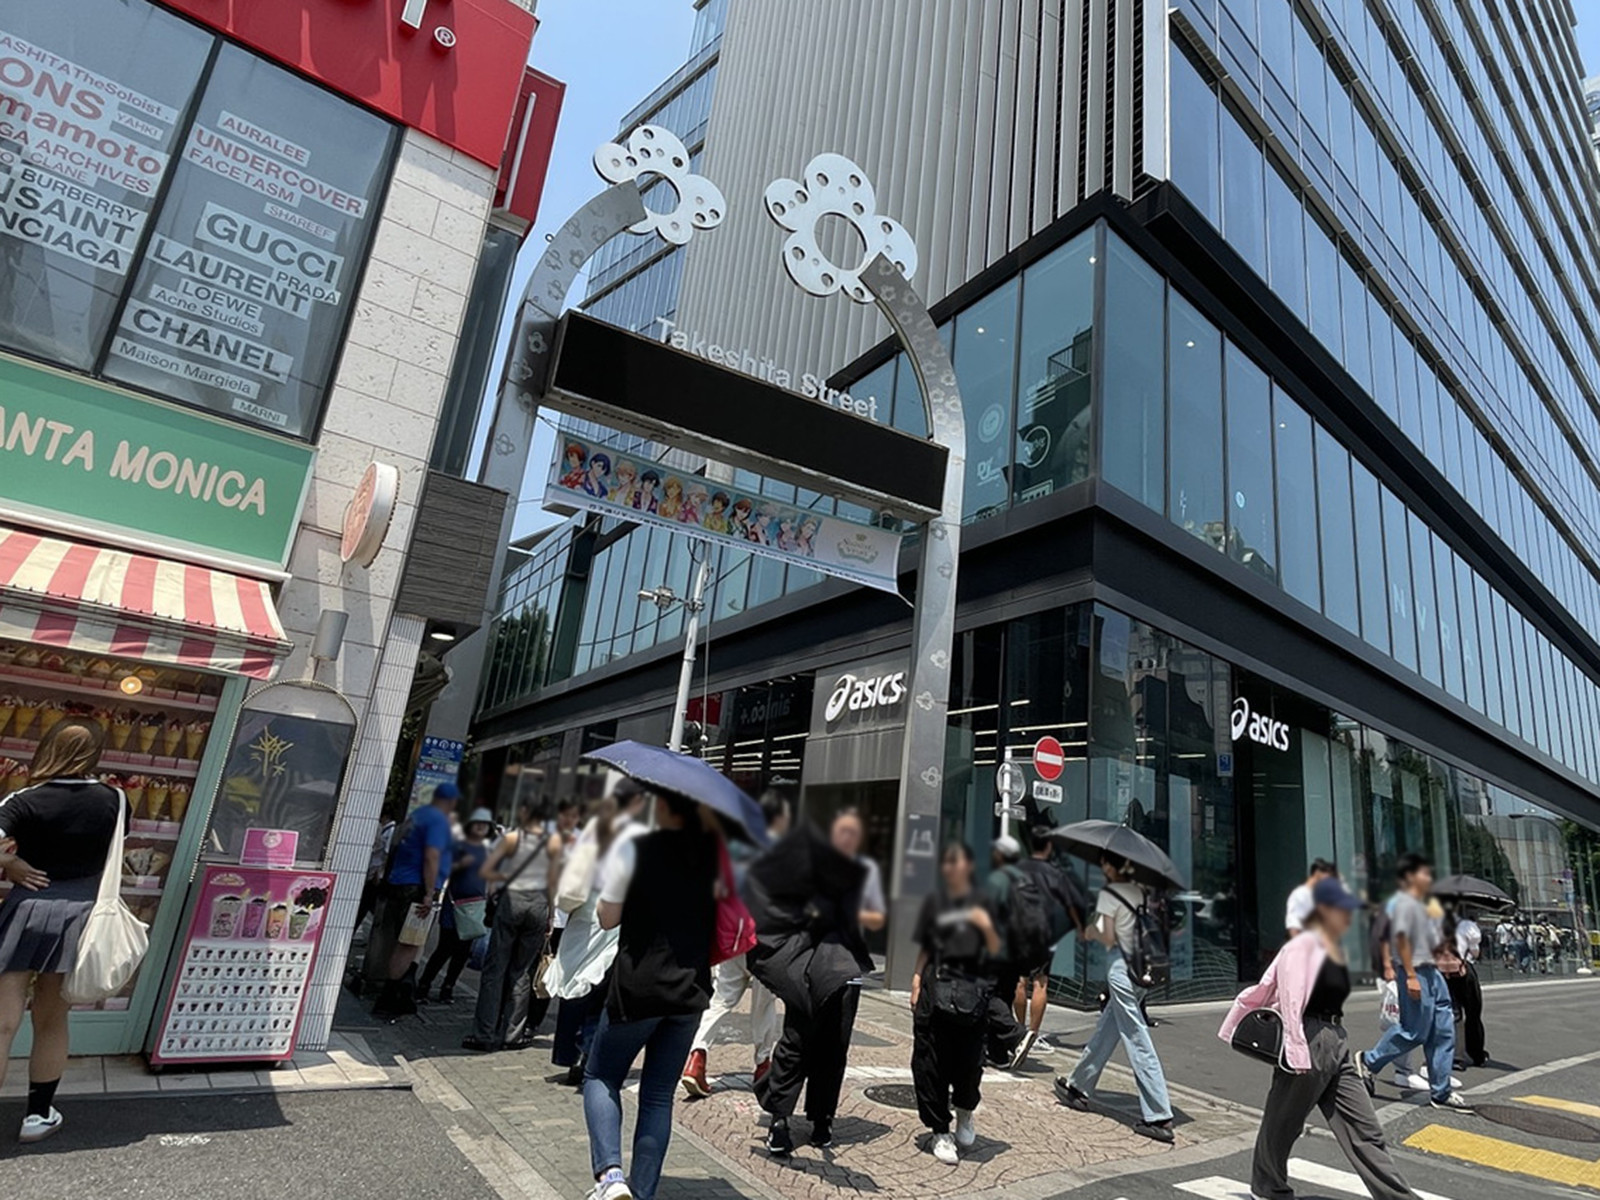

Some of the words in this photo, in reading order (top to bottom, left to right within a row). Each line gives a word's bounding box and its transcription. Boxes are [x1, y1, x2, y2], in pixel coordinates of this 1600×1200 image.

[0, 57, 105, 120] ONS
[35, 139, 151, 193] ARCHIVES
[222, 117, 307, 162] AURALEE
[30, 152, 88, 182] CLANE
[189, 148, 295, 203] FACETASM
[195, 129, 362, 214] UNDERCOVER
[15, 186, 135, 244] SAINT
[21, 168, 139, 222] BURBERRY
[269, 205, 332, 238] SHAREEF
[153, 238, 309, 313] LAURENT
[206, 213, 337, 284] GUCCI
[155, 289, 197, 311] Acne
[201, 304, 259, 334] Studios
[182, 281, 259, 318] LOEWE
[276, 271, 337, 304] PRADA
[119, 342, 180, 372] Maison
[184, 363, 251, 394] Margiela
[133, 308, 281, 377] CHANEL
[656, 316, 791, 389] Takeshita
[801, 372, 879, 422] Street
[239, 402, 281, 422] MARNI
[0, 407, 94, 472] NTA
[109, 440, 266, 516] MONICA
[849, 672, 904, 710] asics
[1249, 711, 1290, 751] asics
